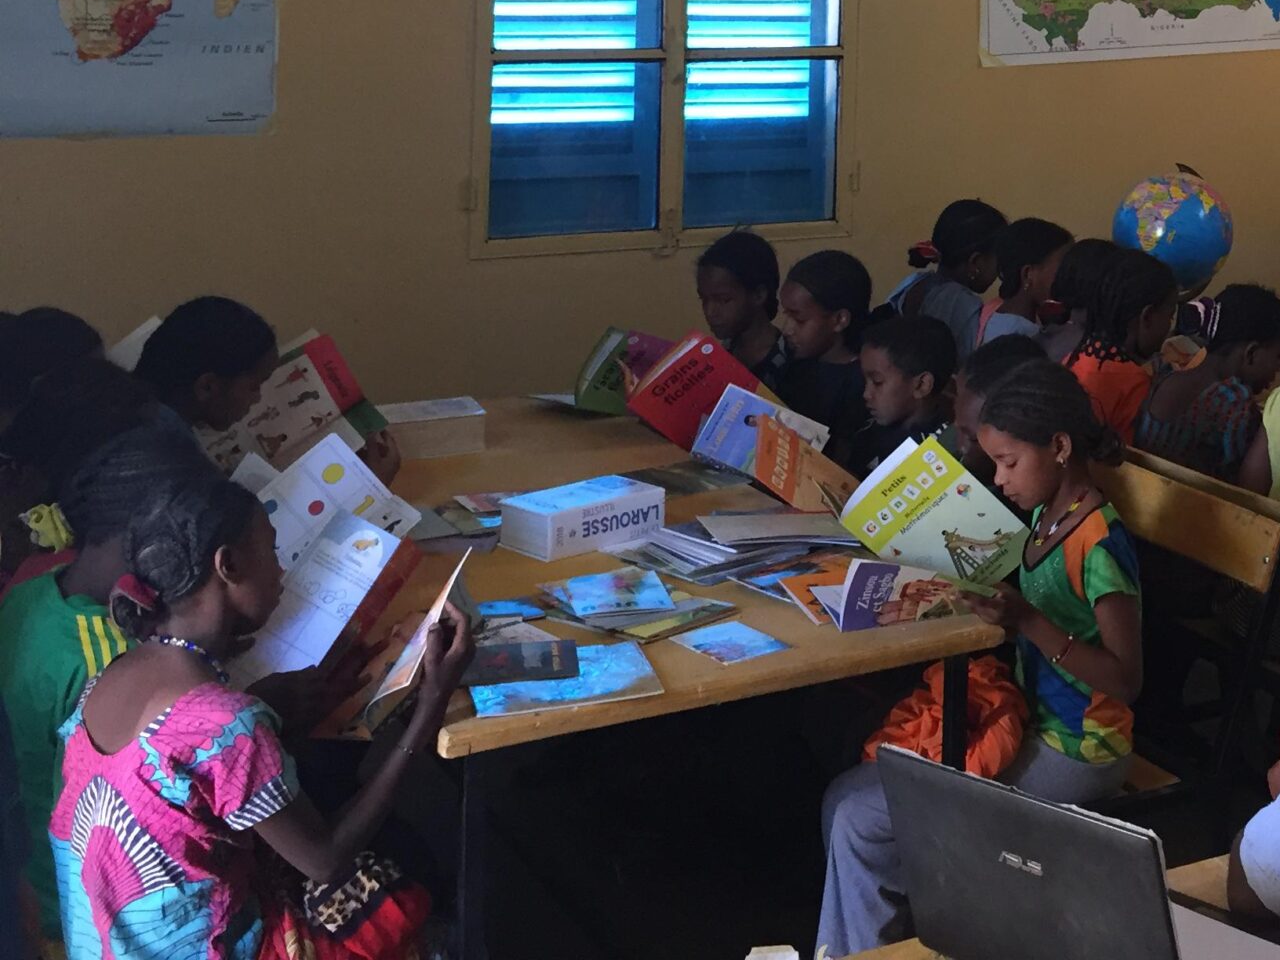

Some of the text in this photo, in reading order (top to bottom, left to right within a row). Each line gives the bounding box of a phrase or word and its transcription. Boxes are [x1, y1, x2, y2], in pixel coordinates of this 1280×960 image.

[201, 44, 265, 54] INDIEN
[652, 358, 698, 397] Grains
[881, 475, 907, 497] Petits
[582, 505, 660, 538] LAROUSSE
